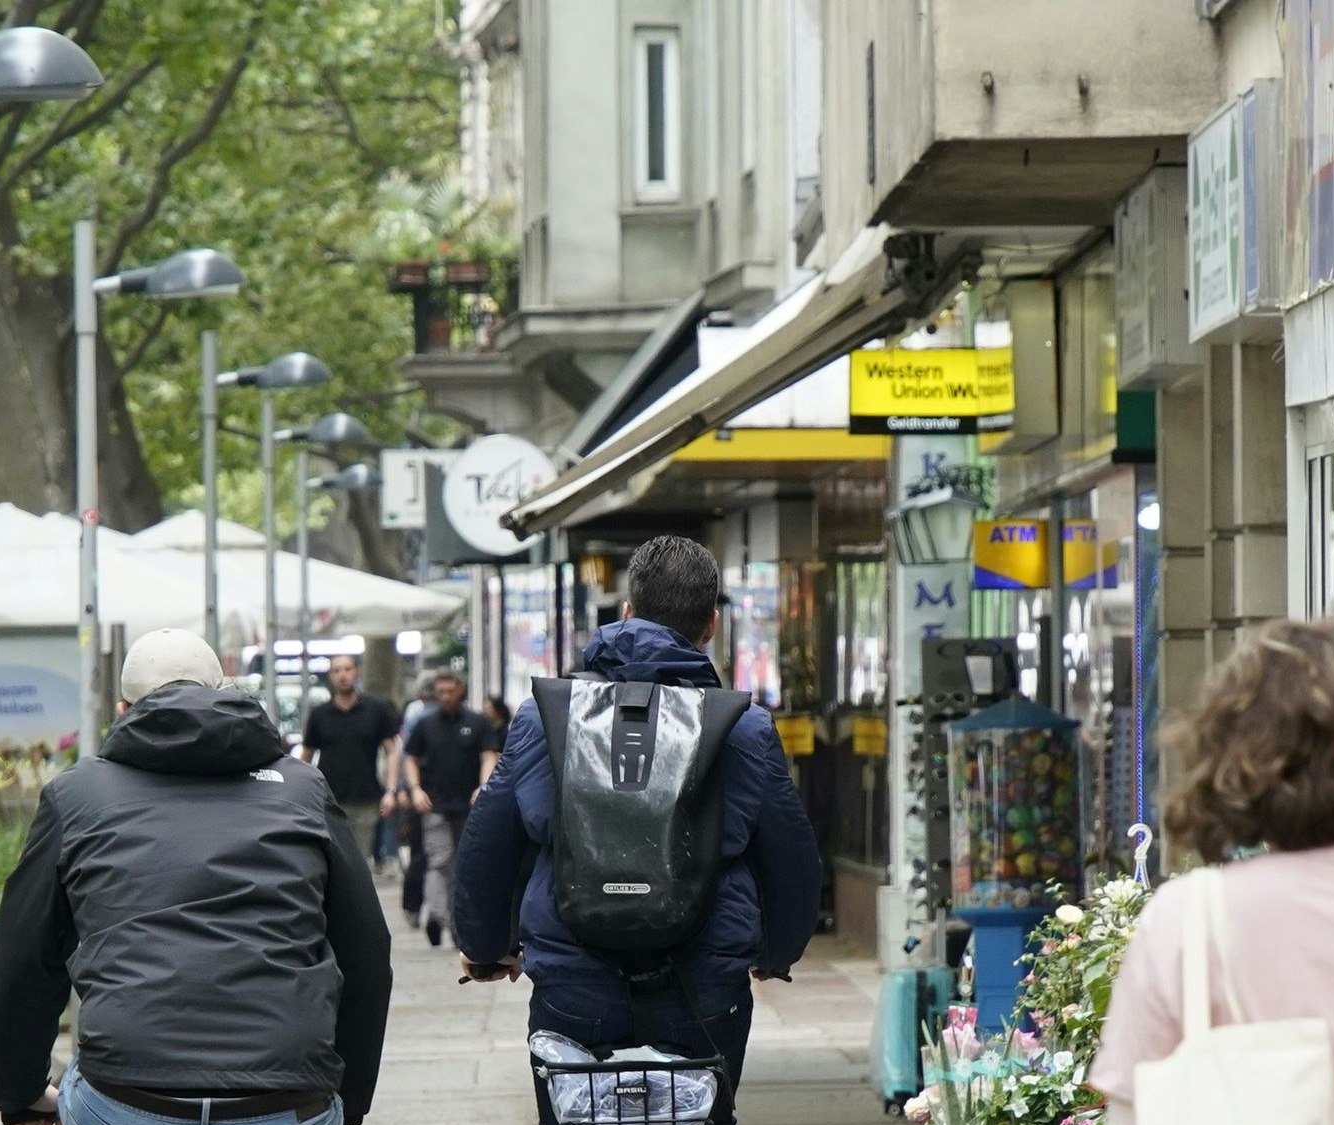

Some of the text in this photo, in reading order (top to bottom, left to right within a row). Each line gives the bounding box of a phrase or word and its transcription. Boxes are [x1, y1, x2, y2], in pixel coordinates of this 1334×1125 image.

[866, 362, 944, 378] Western
[892, 383, 943, 399] Union
[887, 416, 961, 431] Geldtransfer
[989, 526, 1038, 543] ATM
